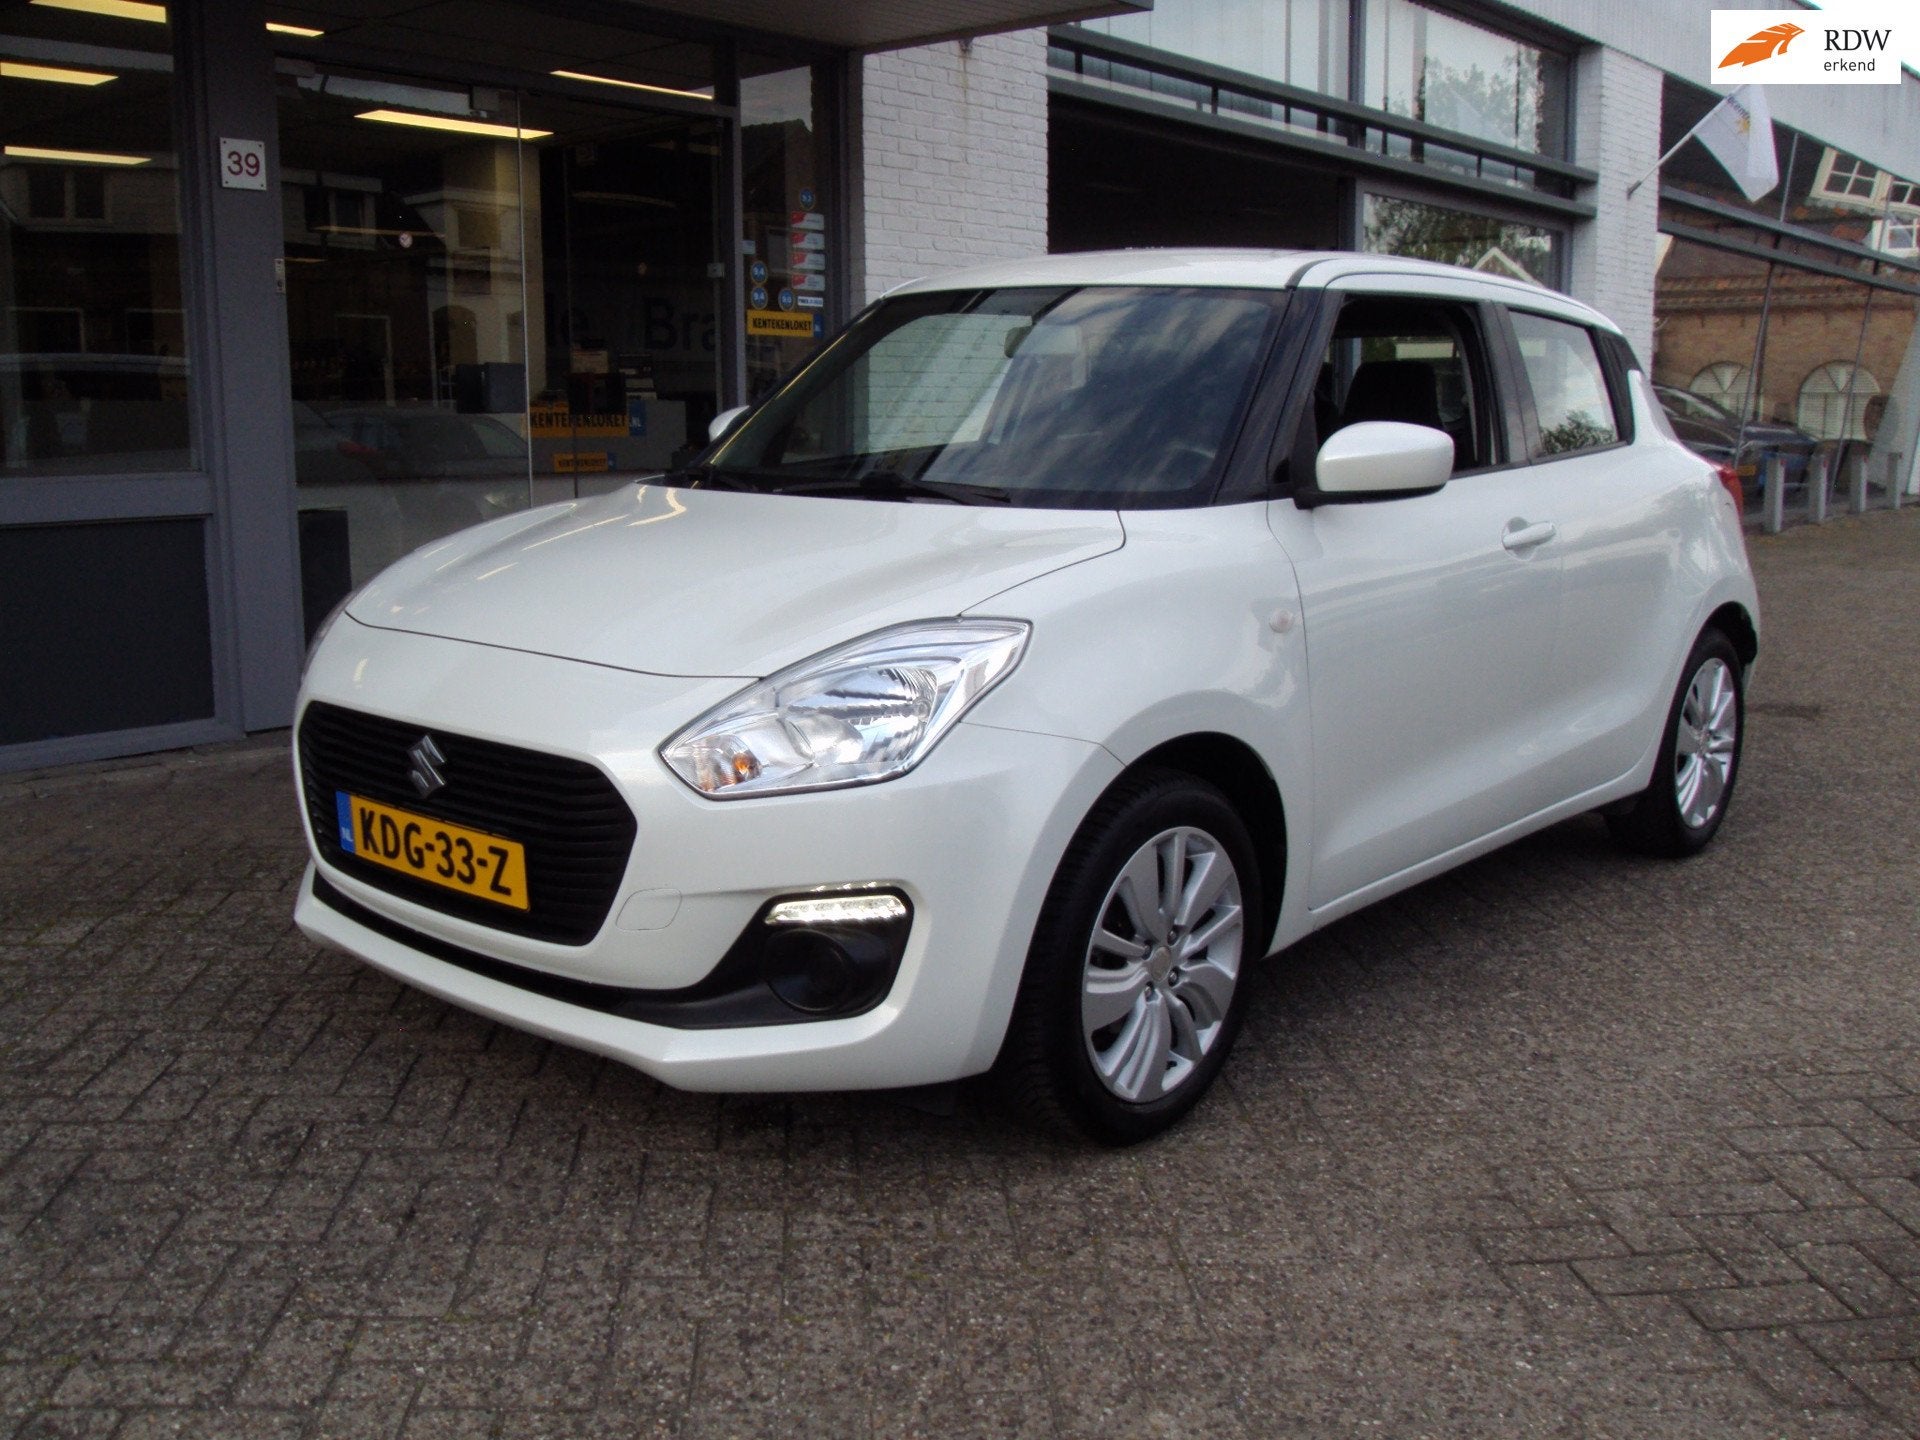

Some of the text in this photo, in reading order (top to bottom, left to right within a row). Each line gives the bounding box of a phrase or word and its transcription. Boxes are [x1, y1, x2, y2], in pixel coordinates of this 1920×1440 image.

[227, 150, 261, 177] 39
[752, 317, 812, 332] KENTEKENLOKET
[358, 806, 513, 897] KDG-33-Z
